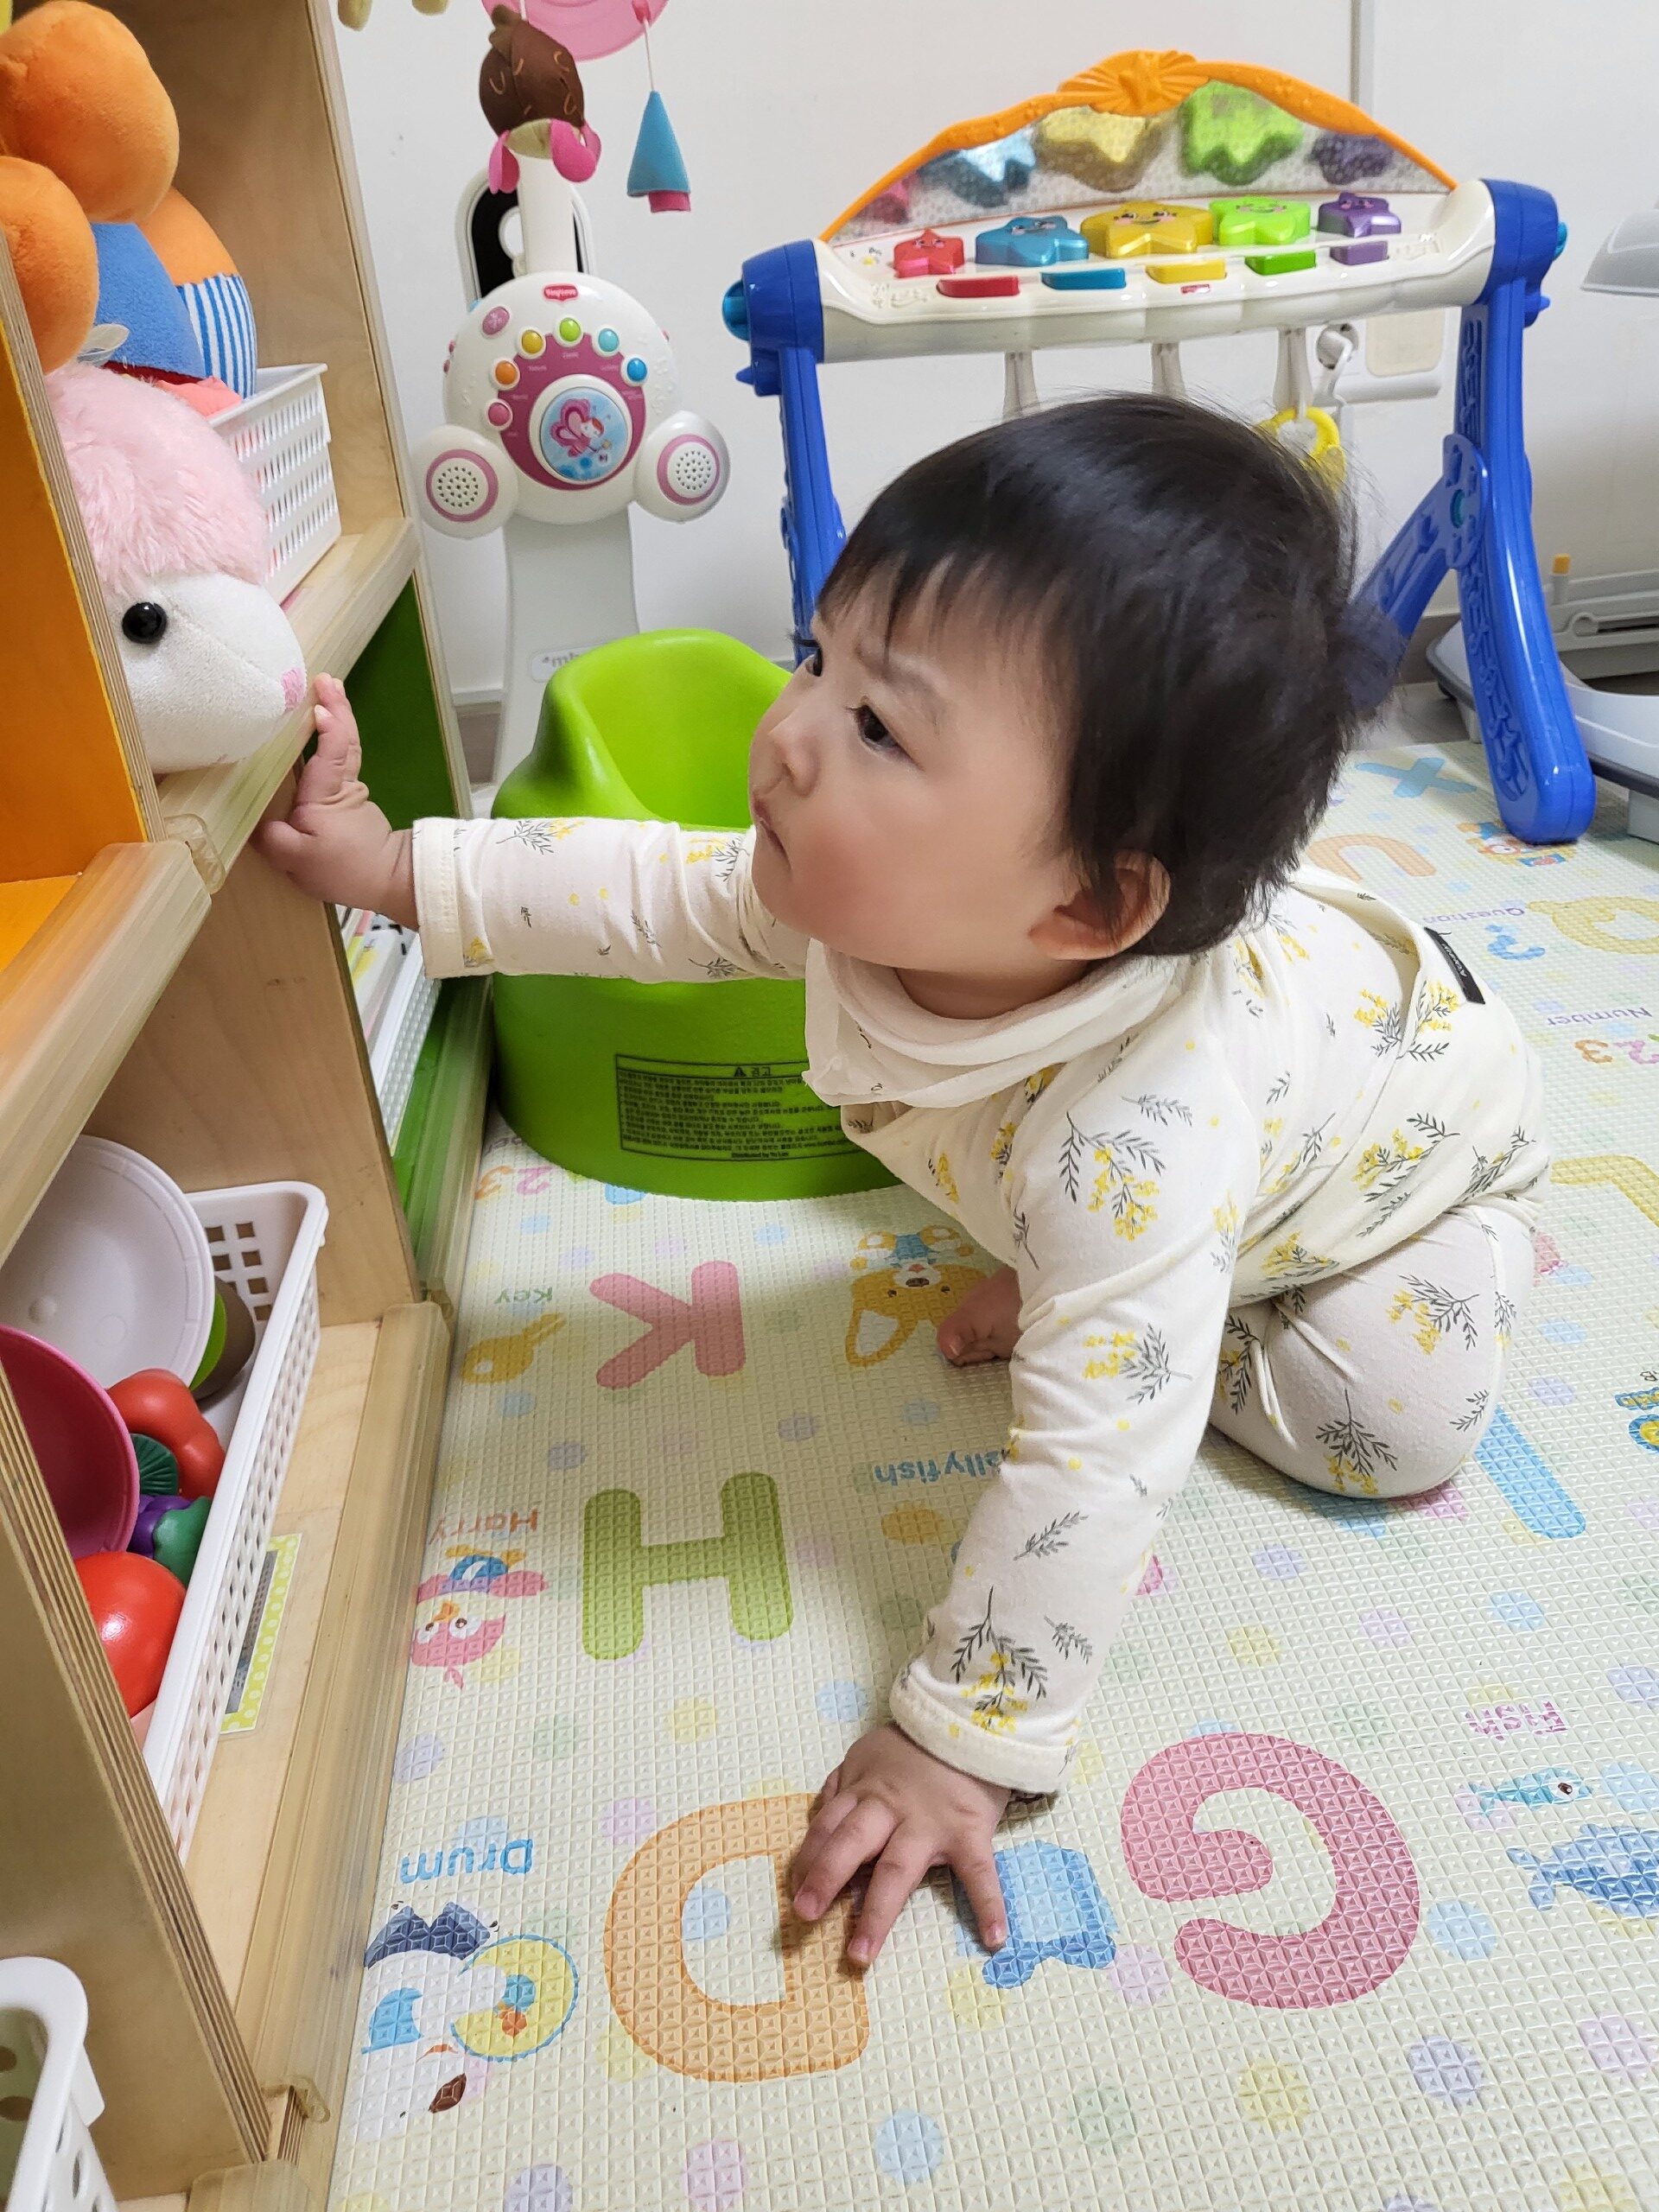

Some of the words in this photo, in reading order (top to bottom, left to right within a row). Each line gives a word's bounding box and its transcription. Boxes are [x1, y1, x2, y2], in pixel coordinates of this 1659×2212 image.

[1423, 907, 1525, 924] Question
[1547, 1007, 1653, 1027] Number
[493, 1287, 553, 1305] Key
[588, 1260, 748, 1390] K
[874, 1450, 1002, 1486] ellyfish
[429, 1509, 538, 1546] Harry
[583, 1472, 794, 1661] H
[1465, 1700, 1568, 1741] Fish
[399, 1839, 534, 1885] Drum
[1121, 1732, 1421, 2010] G
[603, 1792, 871, 2083] D
